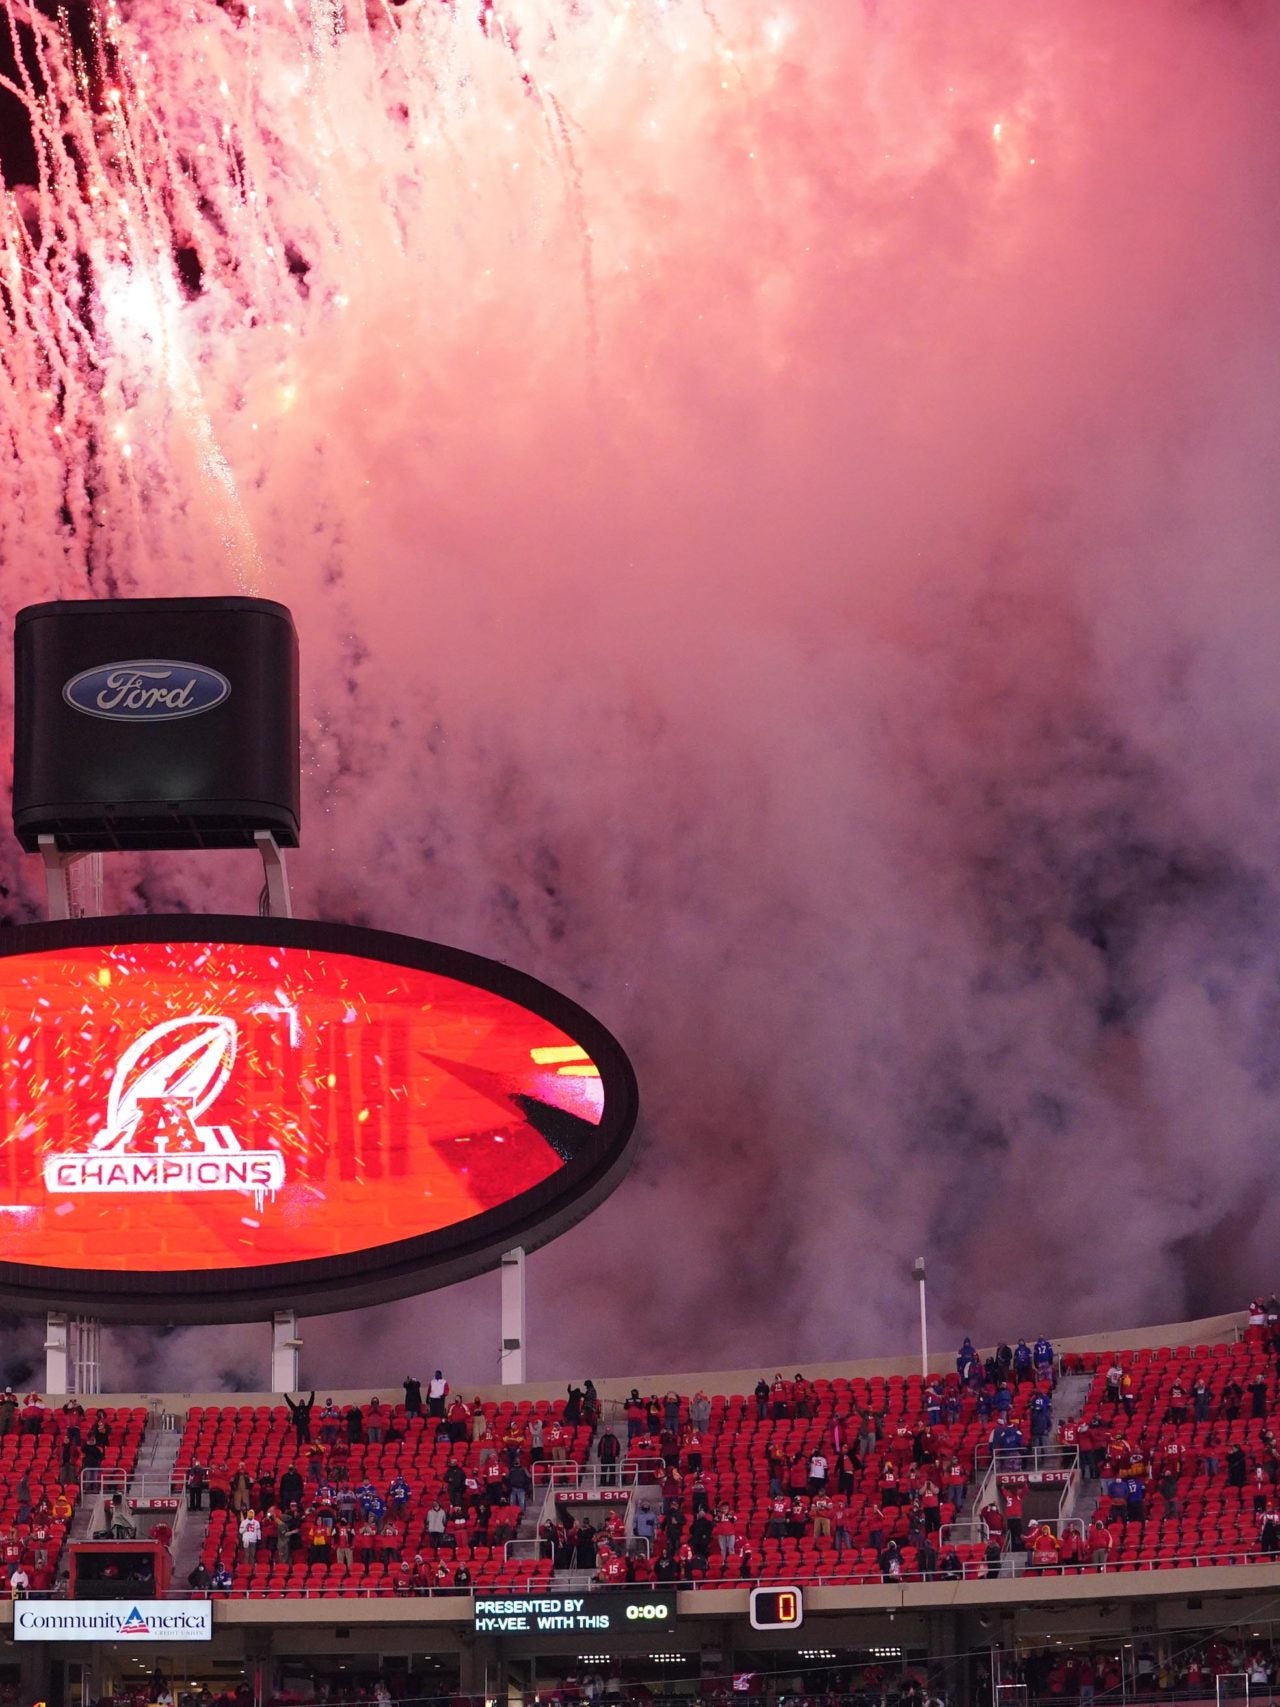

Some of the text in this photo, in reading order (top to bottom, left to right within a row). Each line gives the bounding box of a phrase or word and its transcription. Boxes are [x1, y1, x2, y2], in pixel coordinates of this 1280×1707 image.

[97, 670, 197, 710] Ford
[57, 1161, 272, 1188] CHAMPIONS
[1037, 1345, 1047, 1354] 17
[1064, 1430, 1074, 1441] 15
[489, 1467, 499, 1476] 15
[951, 1466, 961, 1476] 15
[1045, 1473, 1070, 1481] 315
[1128, 1484, 1137, 1493] 17
[604, 1492, 628, 1500] 314
[37, 1531, 45, 1539] 10
[609, 1564, 618, 1574] 15
[475, 1599, 584, 1614] PRESENTED BY
[779, 1594, 794, 1621] 0
[626, 1605, 668, 1619] 0:00
[20, 1606, 206, 1633] CommunityAmerica
[475, 1616, 609, 1631] HY-VEE. WITH THIS
